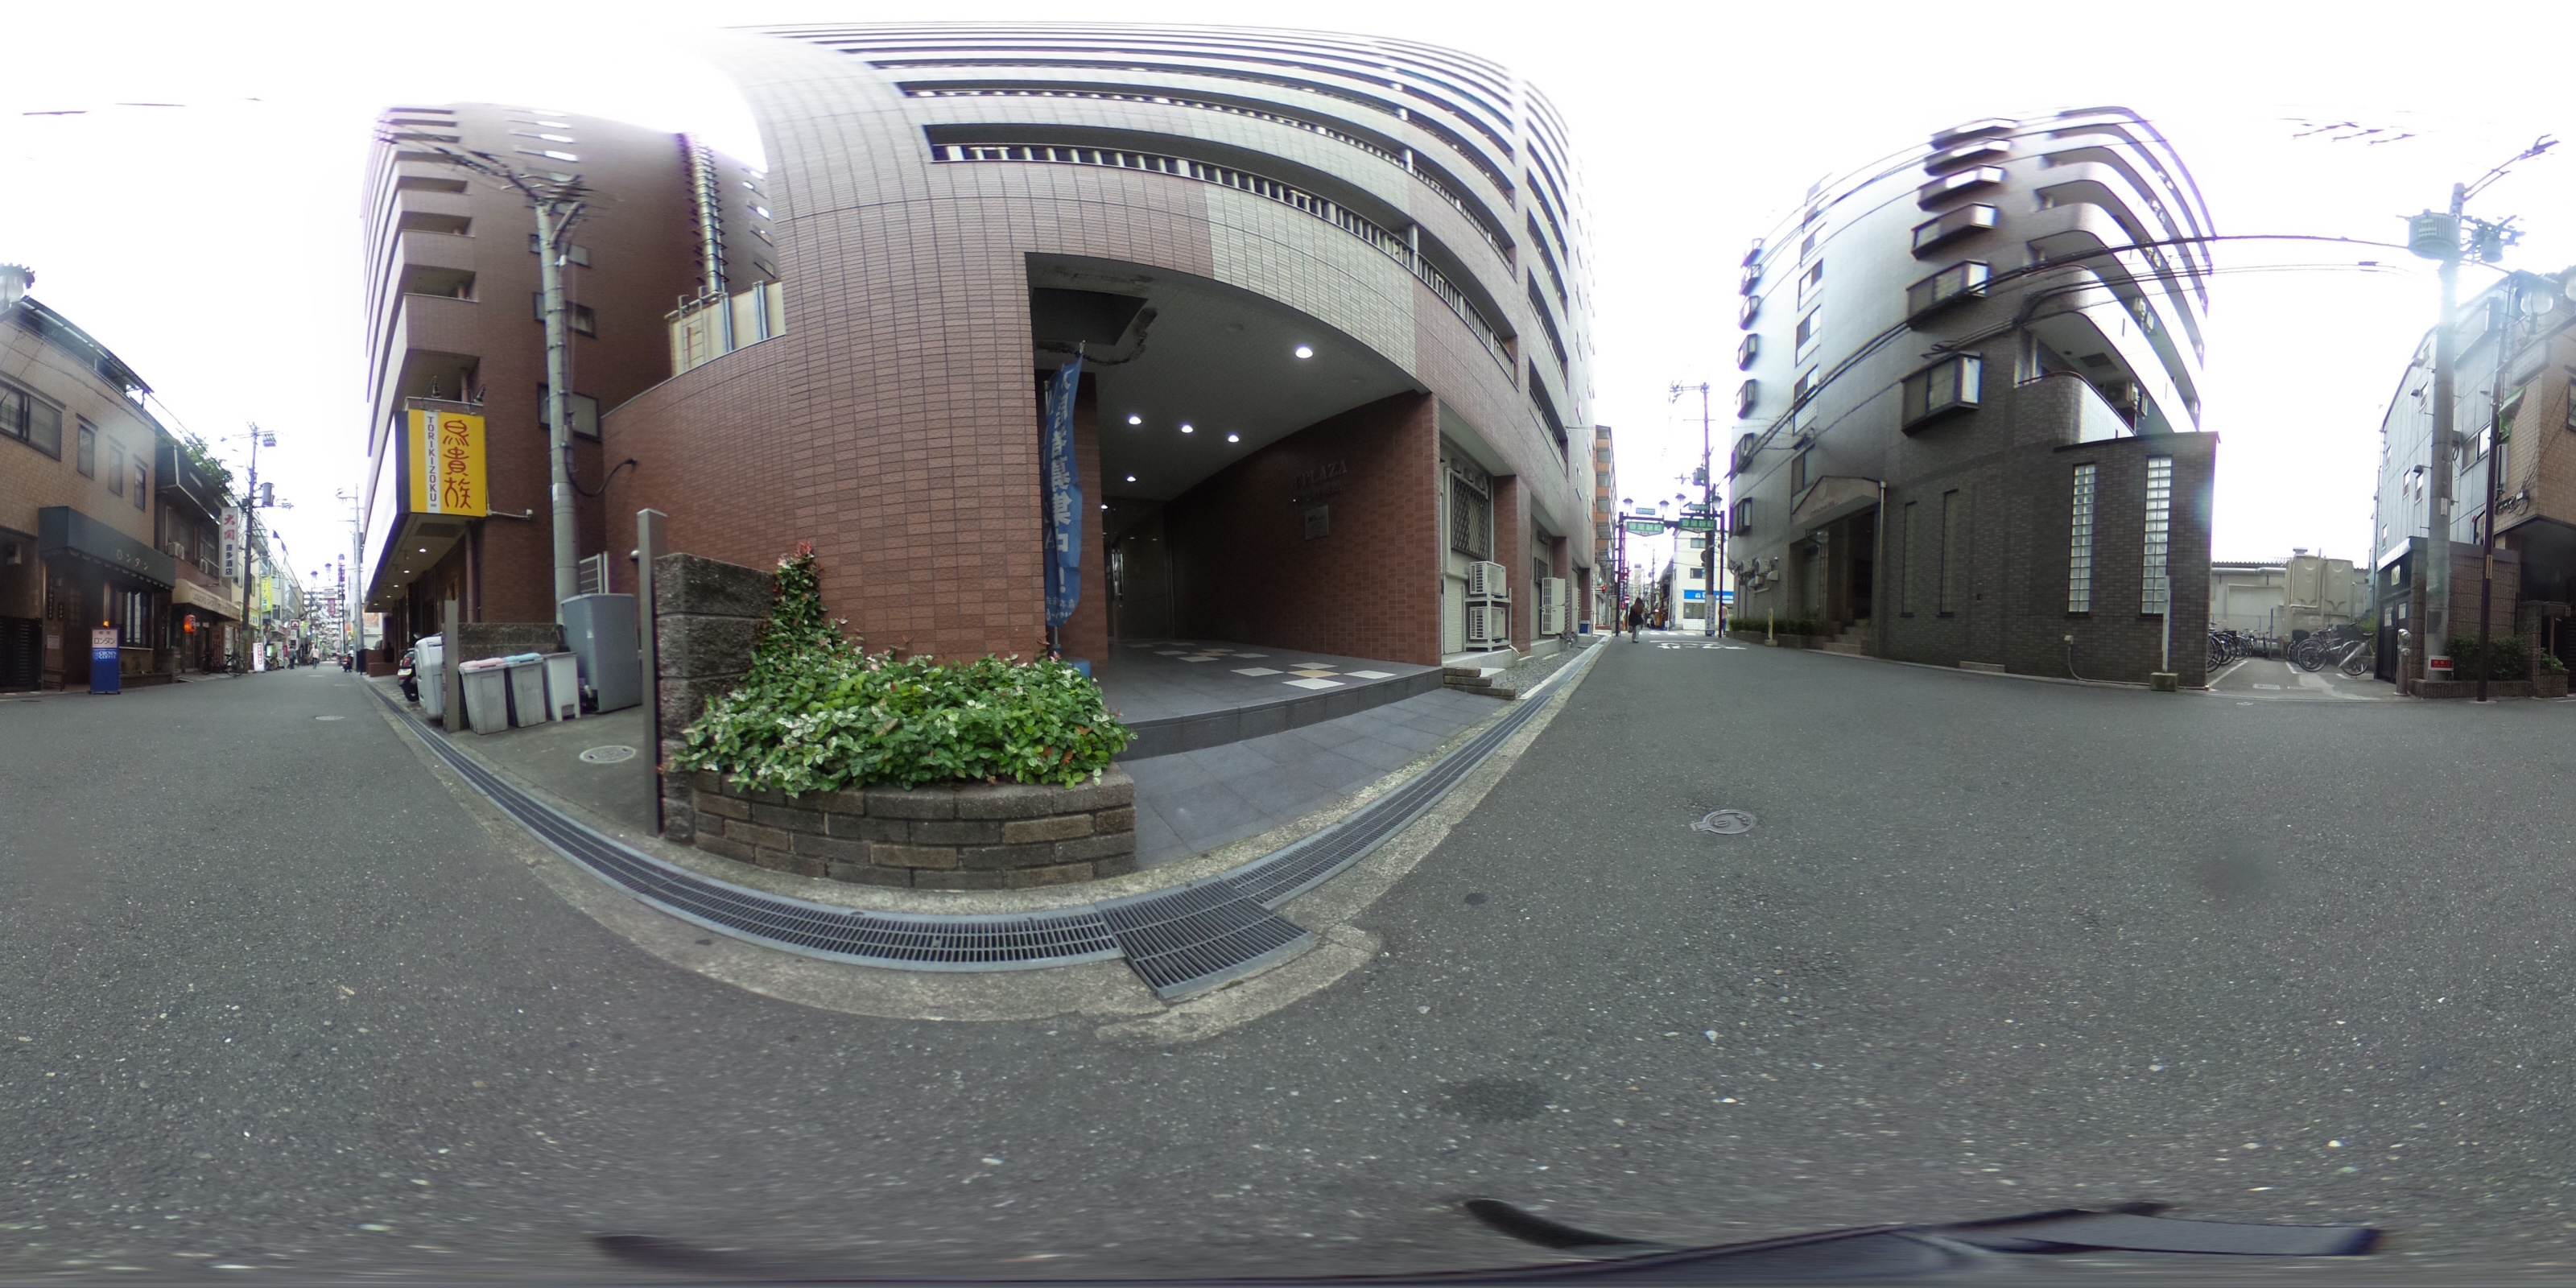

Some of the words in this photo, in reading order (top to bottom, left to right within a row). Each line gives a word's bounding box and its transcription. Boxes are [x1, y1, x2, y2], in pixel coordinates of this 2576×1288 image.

[427, 415, 437, 502] TORIKIZOKU
[443, 419, 472, 510] 鳥貴族
[116, 548, 149, 571] ロンタン
